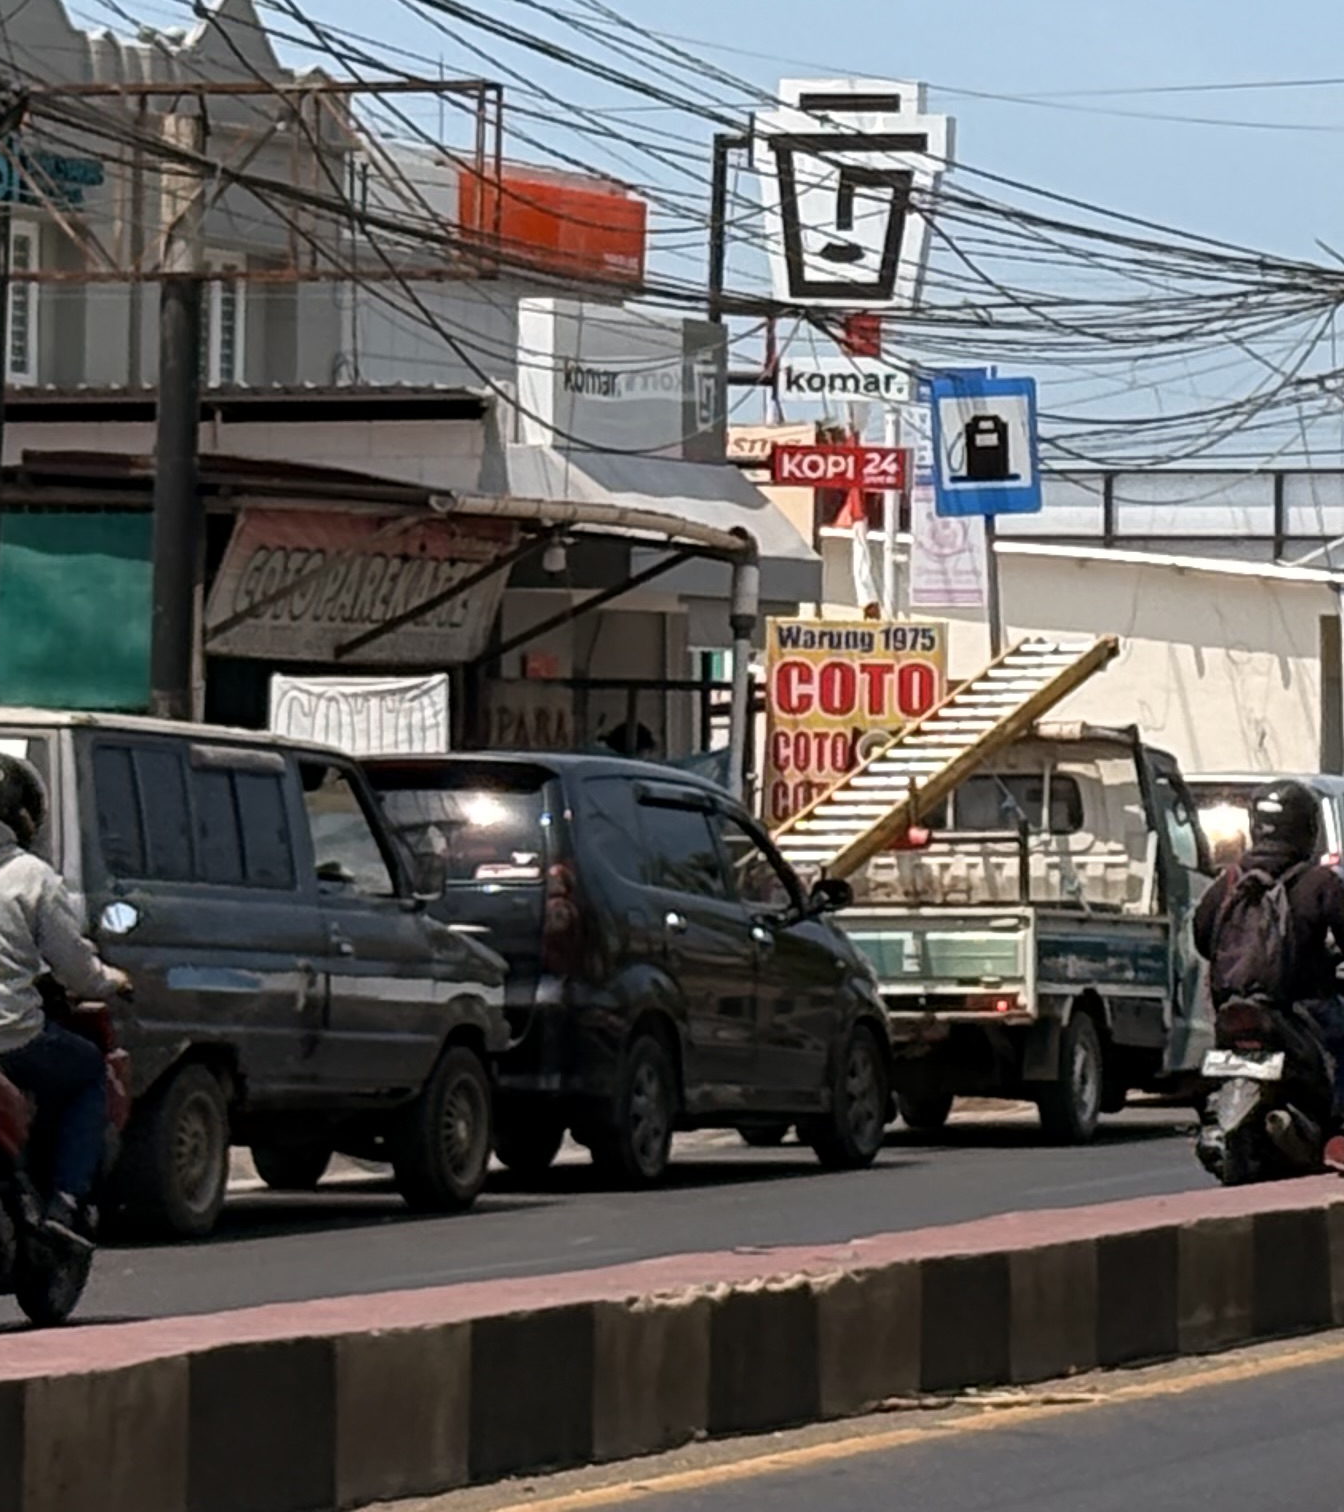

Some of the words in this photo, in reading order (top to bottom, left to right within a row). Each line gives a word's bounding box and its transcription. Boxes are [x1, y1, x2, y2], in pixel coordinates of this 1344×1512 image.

[785, 365, 906, 396] komar.
[781, 453, 856, 480] KOPI
[862, 452, 899, 475] 24
[778, 624, 875, 652] Warung
[880, 627, 937, 651] 1975
[775, 660, 935, 717] COTO
[772, 730, 850, 774] COTO
[771, 780, 831, 821] COT
